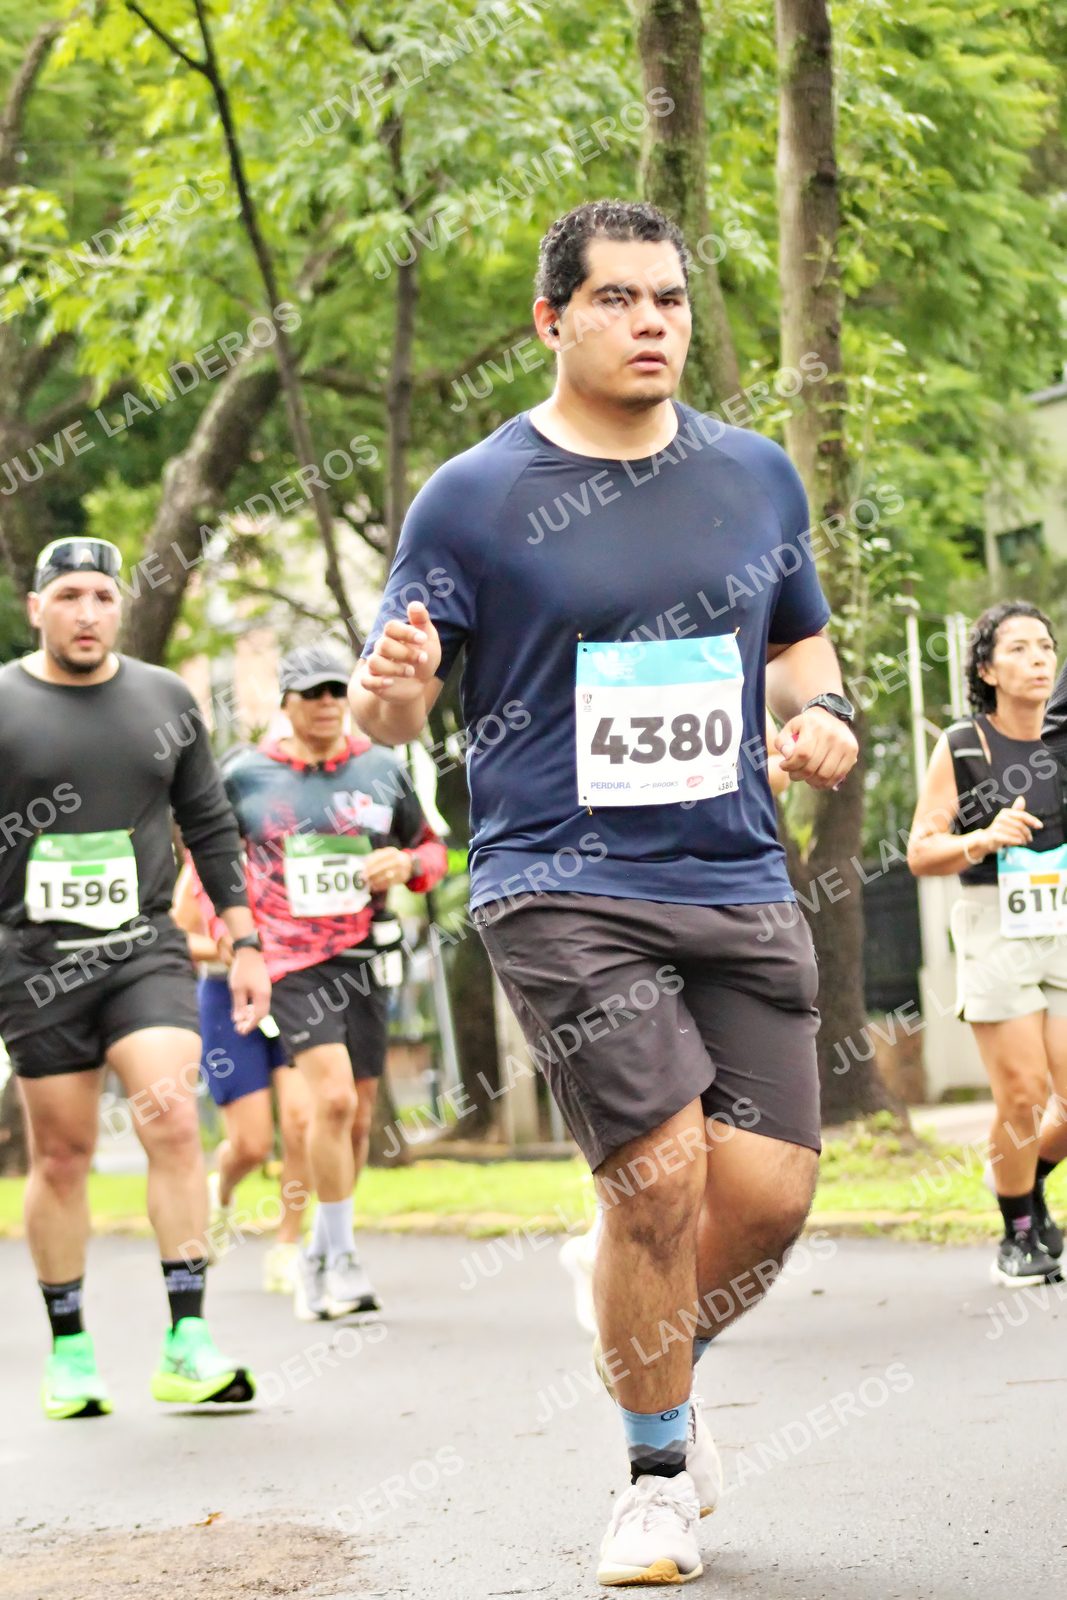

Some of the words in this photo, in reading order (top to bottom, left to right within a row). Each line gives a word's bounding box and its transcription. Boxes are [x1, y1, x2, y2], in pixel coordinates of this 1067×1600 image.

[591, 709, 732, 764] 4380
[40, 879, 128, 908] 1596
[299, 871, 365, 894] 1506
